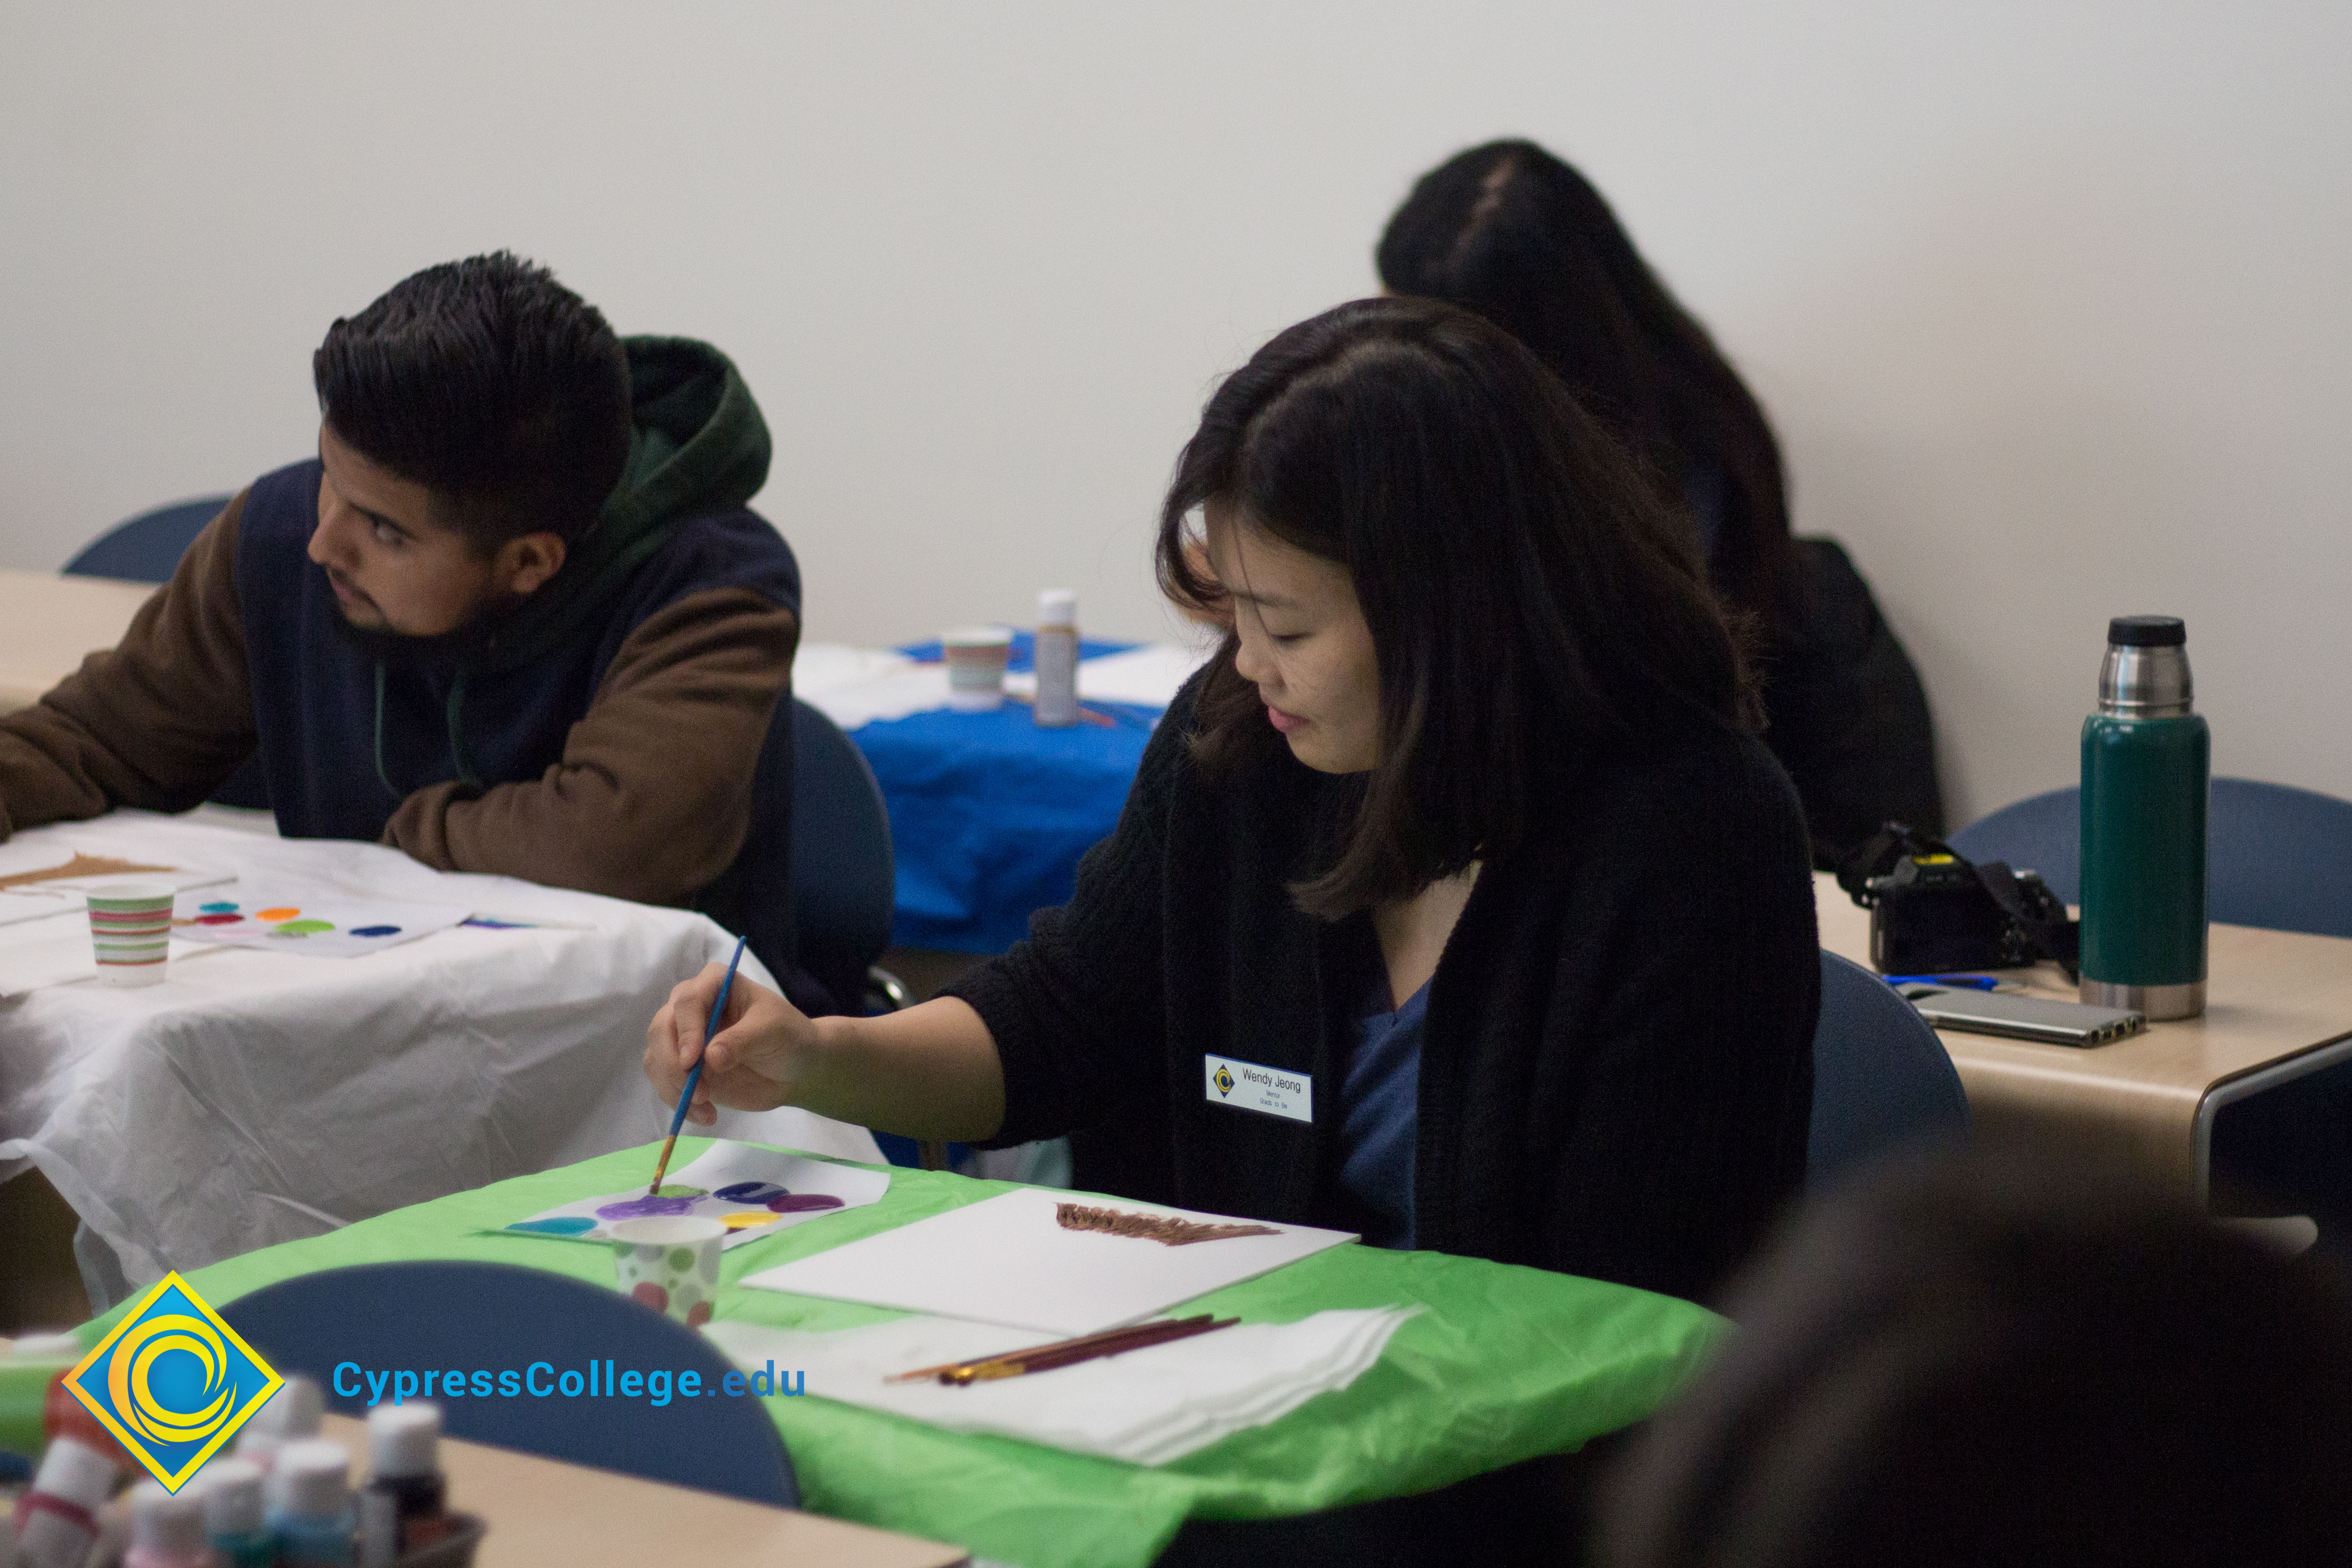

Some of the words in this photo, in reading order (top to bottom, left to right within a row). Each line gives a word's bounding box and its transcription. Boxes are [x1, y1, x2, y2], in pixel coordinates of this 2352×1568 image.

[1242, 1067, 1273, 1087] Wendy
[1275, 1075, 1301, 1094] Jeong
[1266, 1089, 1281, 1098] Mentor
